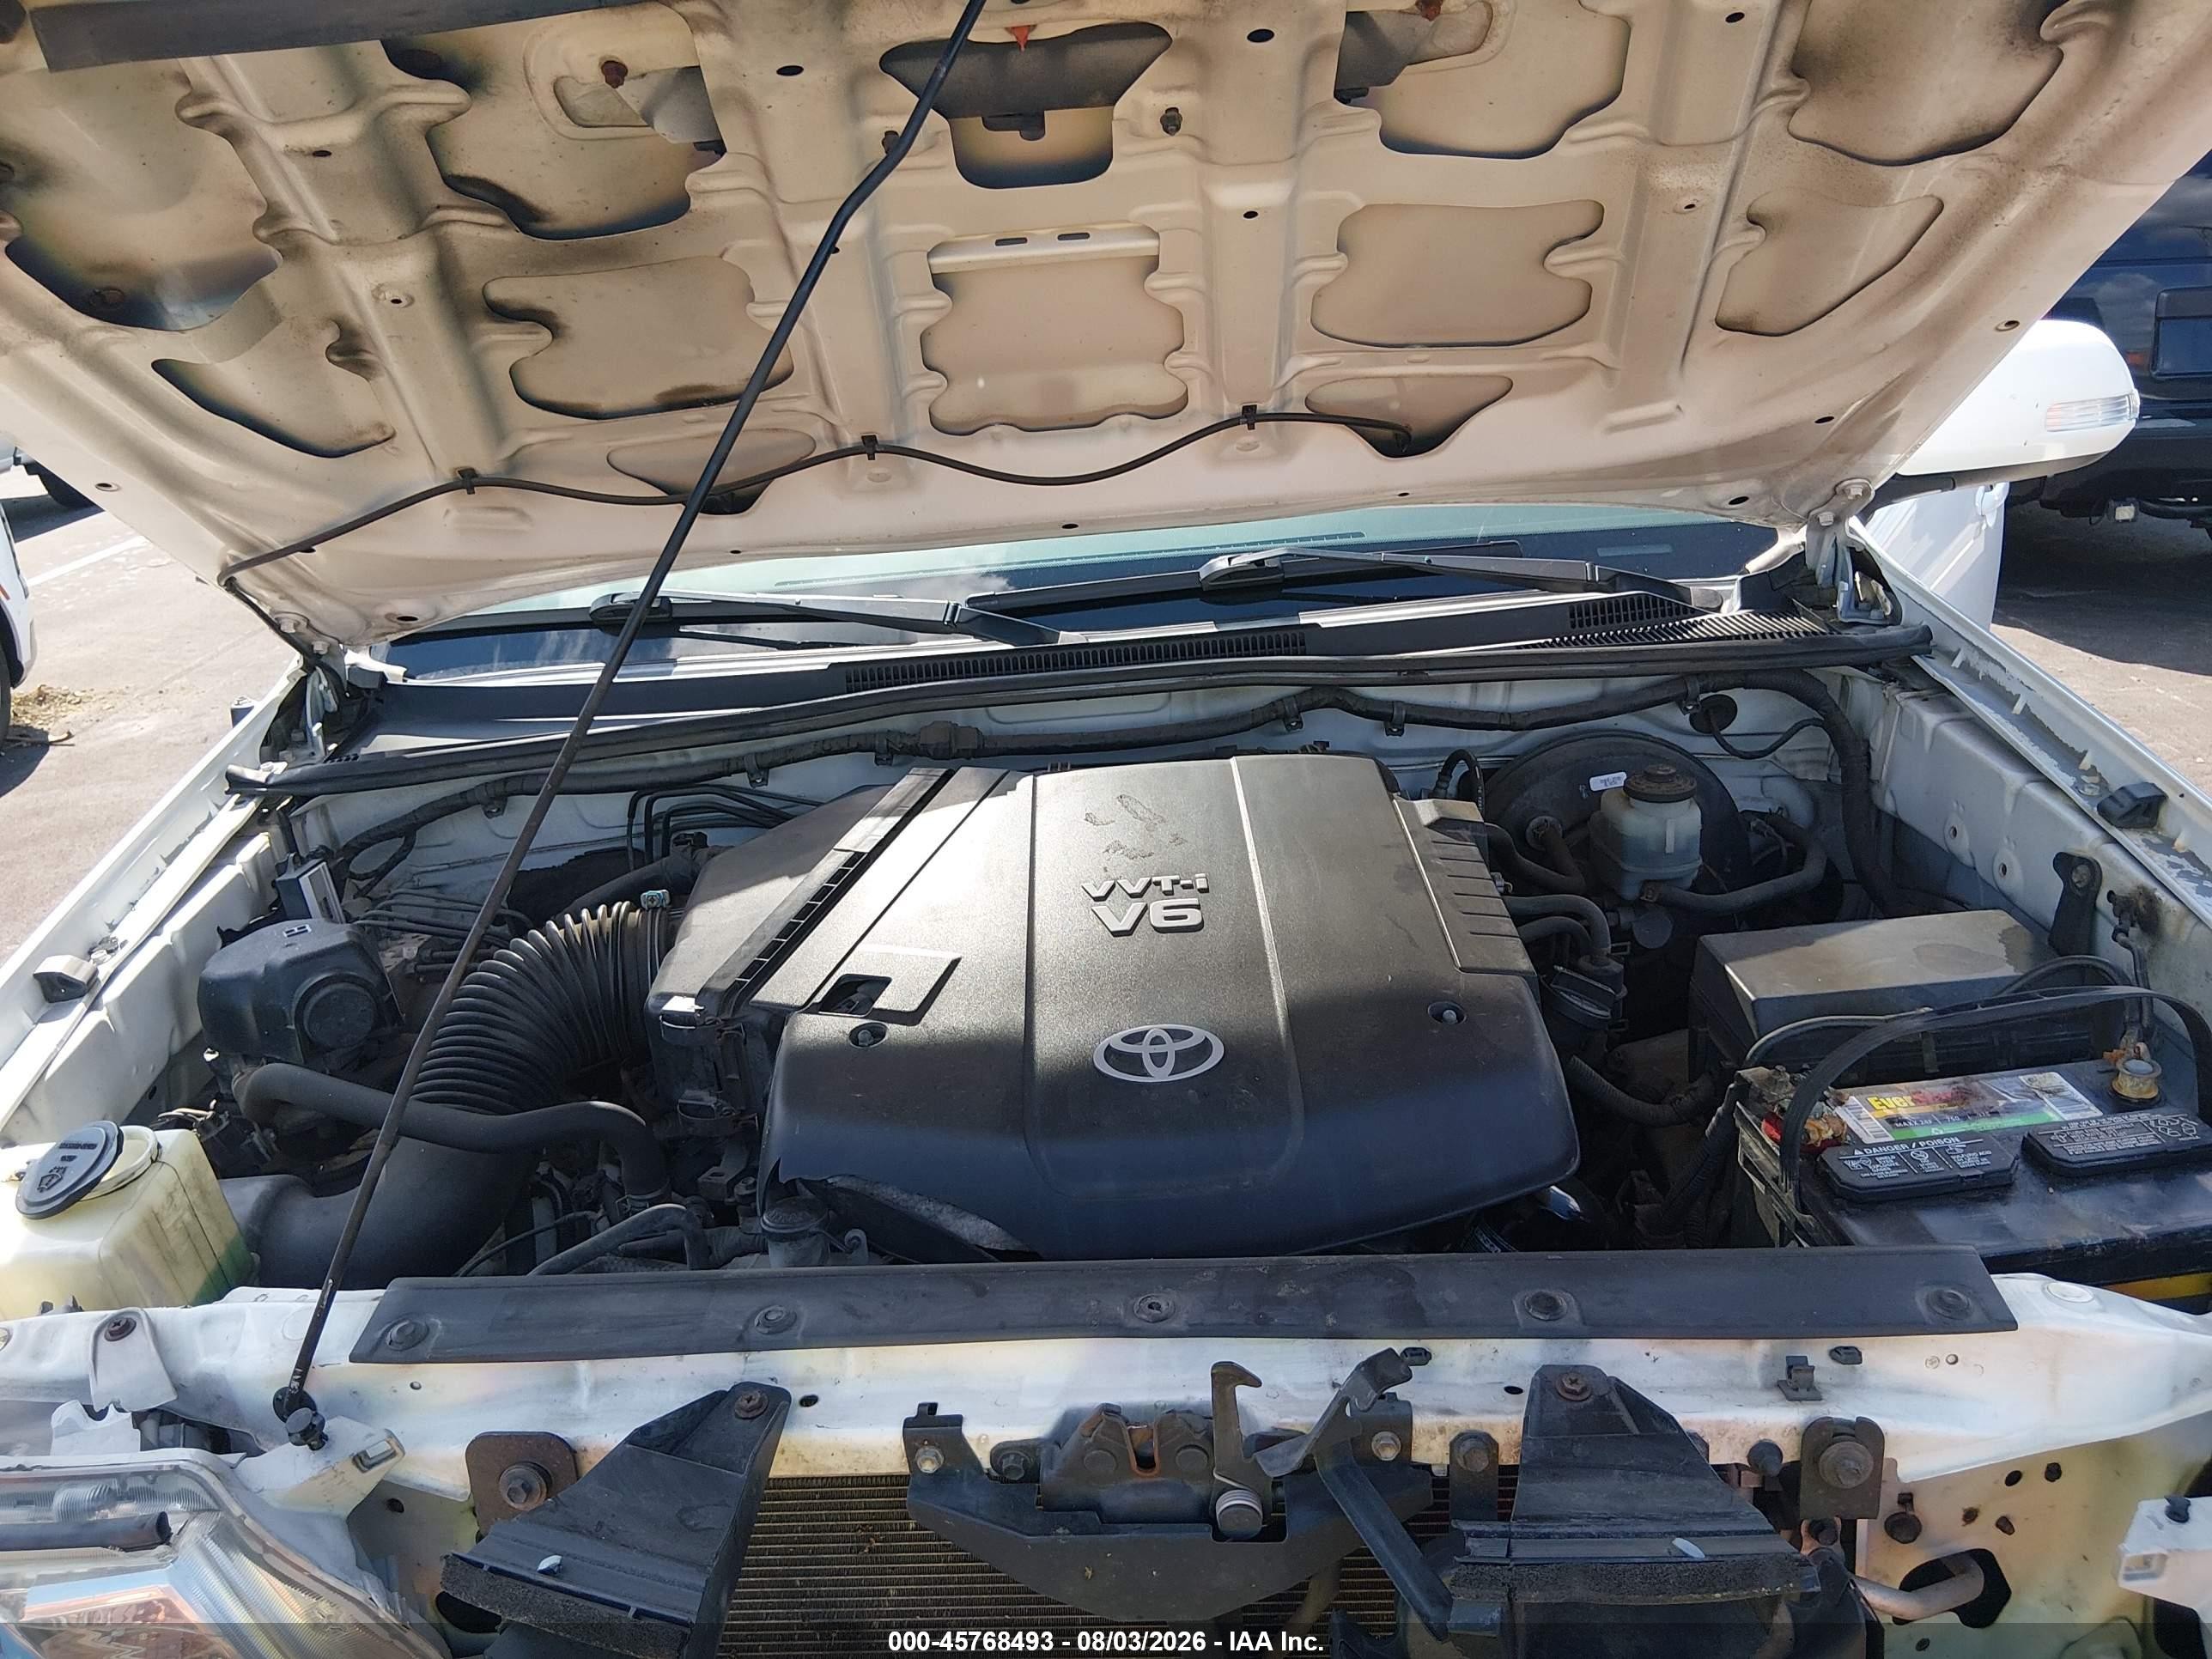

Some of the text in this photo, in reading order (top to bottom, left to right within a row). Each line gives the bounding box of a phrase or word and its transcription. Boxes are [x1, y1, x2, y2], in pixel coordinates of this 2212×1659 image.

[1082, 873, 1210, 902] VVT-i
[1091, 898, 1205, 937] V6
[1863, 1144, 1909, 1155] DANGER
[1918, 1136, 1960, 1147] POISON
